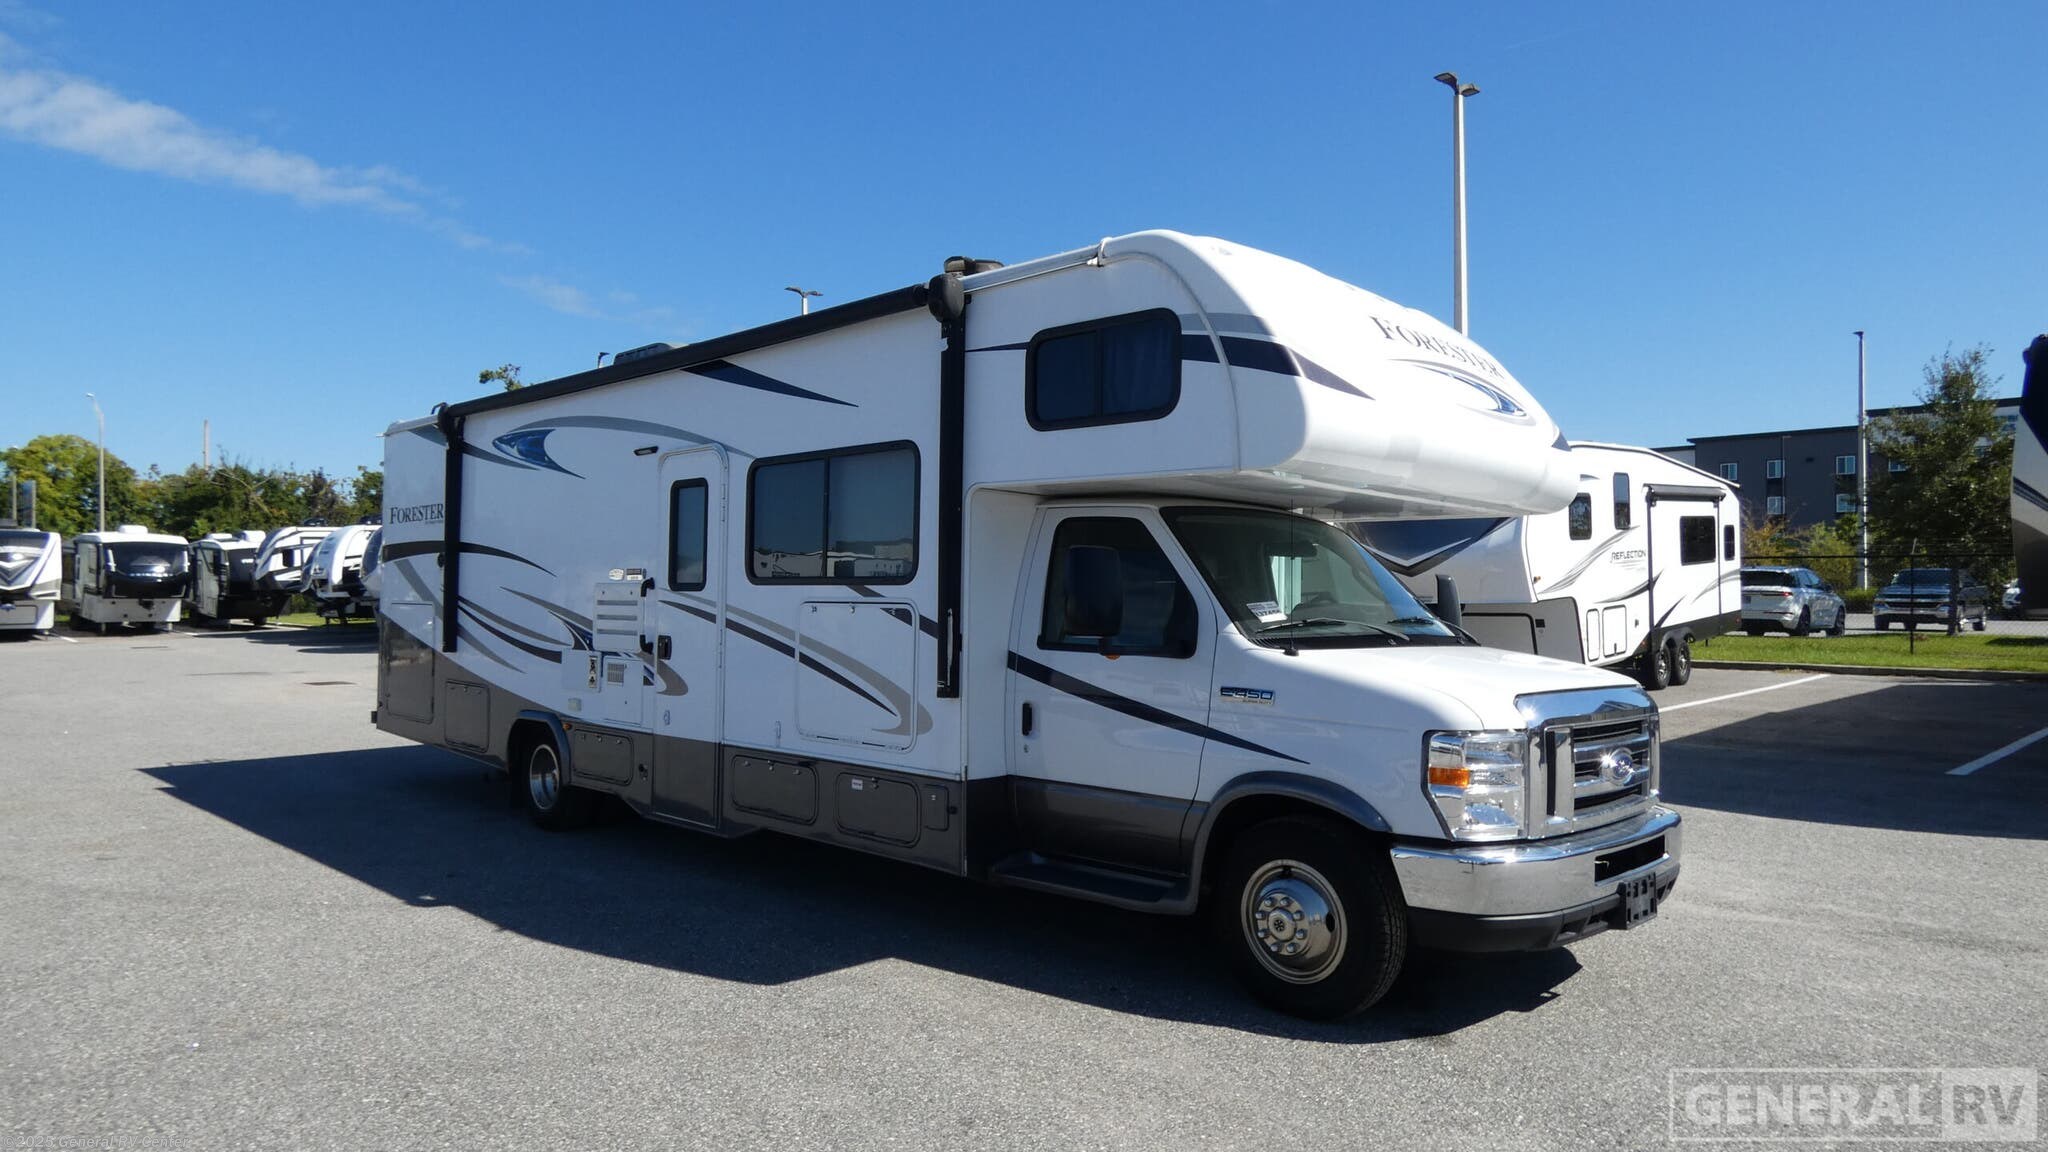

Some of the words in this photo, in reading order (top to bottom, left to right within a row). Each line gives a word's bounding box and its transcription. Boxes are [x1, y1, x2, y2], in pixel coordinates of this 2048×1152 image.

[1368, 314, 1505, 380] FORESTER
[389, 503, 444, 525] FORESTER
[1611, 550, 1647, 560] REFLECTION
